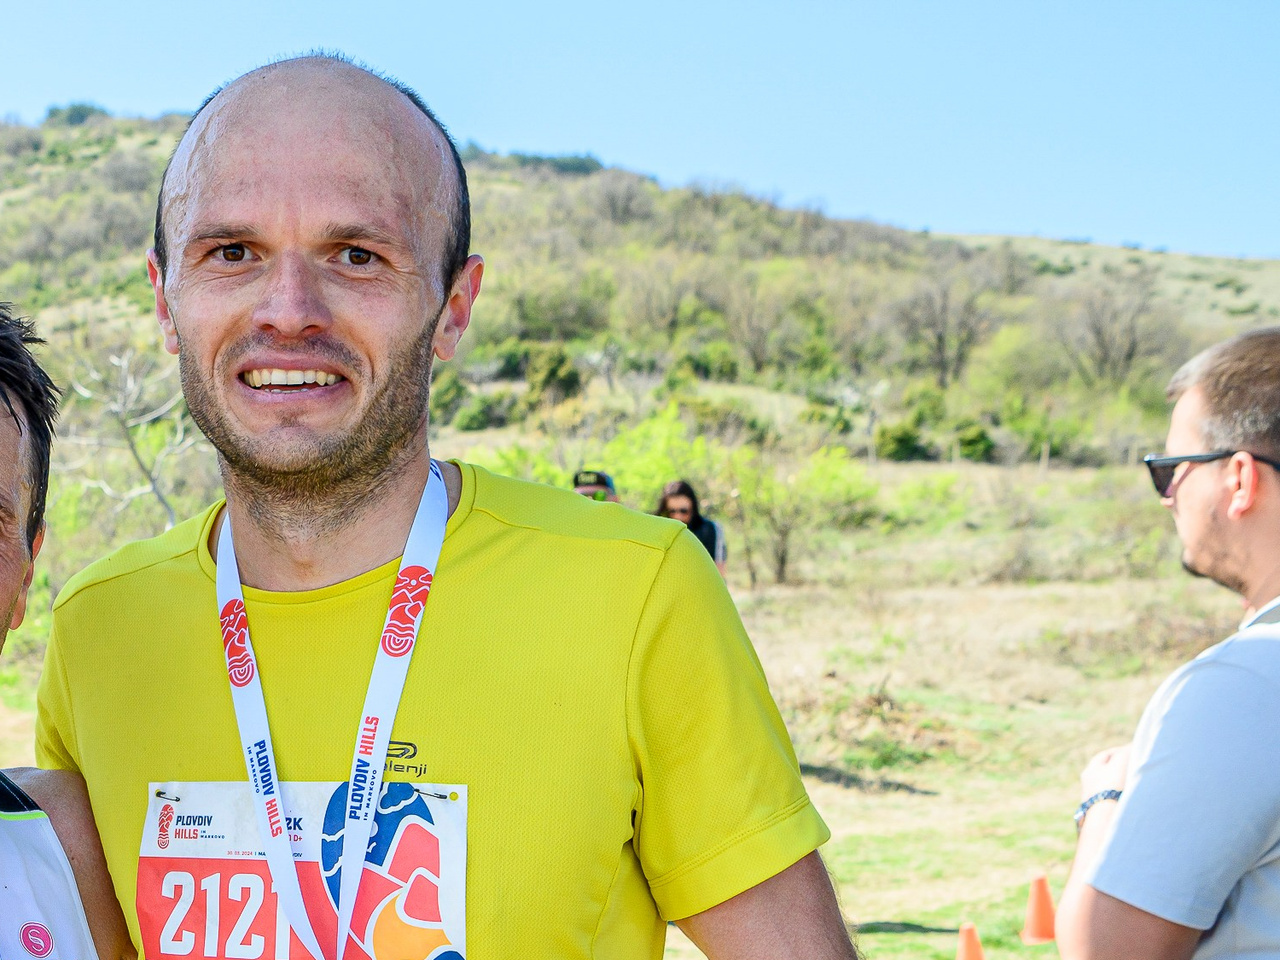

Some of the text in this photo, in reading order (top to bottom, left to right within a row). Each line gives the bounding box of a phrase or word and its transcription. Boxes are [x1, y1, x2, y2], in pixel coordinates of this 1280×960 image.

[349, 715, 380, 820] PLOVDIV HILLS
[384, 760, 427, 778] lenji
[253, 739, 283, 838] PLOVDIV HILLS
[175, 815, 213, 826] PLOVDIV
[285, 817, 303, 831] 2K
[174, 828, 199, 839] HILLS
